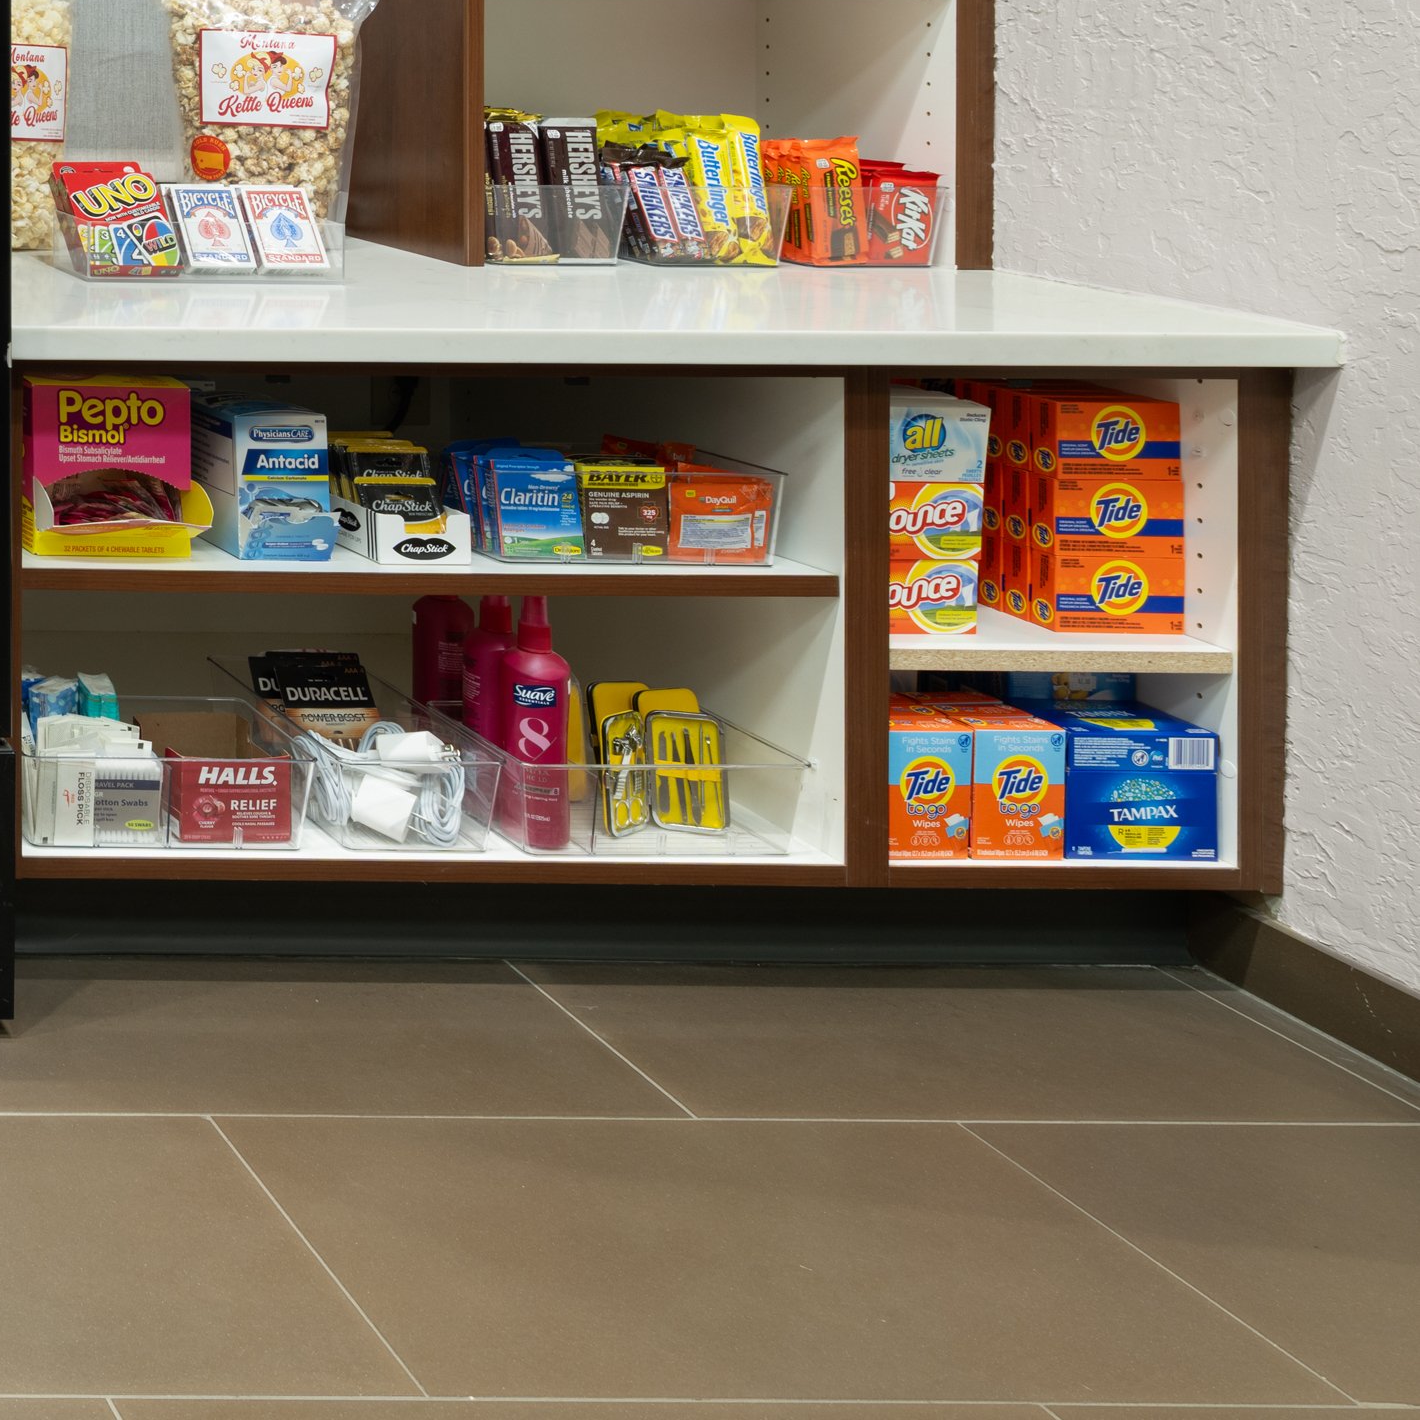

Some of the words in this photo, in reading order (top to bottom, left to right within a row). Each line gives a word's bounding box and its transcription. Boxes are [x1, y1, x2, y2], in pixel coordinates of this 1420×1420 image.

[566, 131, 602, 220] HERSHEY'S
[697, 139, 729, 227] Butterfinger
[73, 174, 155, 215] UNO
[831, 157, 859, 227] Reese's
[181, 191, 234, 213] BICYCLE
[633, 171, 676, 240] SNICKERS
[59, 390, 165, 429] Pepto
[59, 425, 125, 444] Bismol
[253, 428, 312, 441] PhysiciansCARE
[904, 419, 943, 449] all
[1097, 418, 1140, 450] Tide
[59, 446, 82, 455] Bismuth
[84, 447, 122, 456] Subsalicylate
[59, 454, 74, 462] Upset
[75, 454, 100, 462] Stomach
[101, 455, 166, 464] Reliever/Antidiarrheal
[257, 454, 318, 469] Antacid
[588, 471, 647, 482] BAYER
[501, 488, 559, 506] Claritin
[705, 496, 736, 504] DayQuil
[373, 499, 432, 514] ChapStick
[286, 687, 367, 701] DURACELL
[513, 686, 555, 704] Suave
[902, 736, 924, 745] Fights
[926, 736, 955, 745] Stains
[916, 745, 951, 753] Seconds
[231, 800, 276, 811] RELIEF
[1110, 805, 1177, 821] TAMPAX
[912, 819, 941, 828] Wipes
